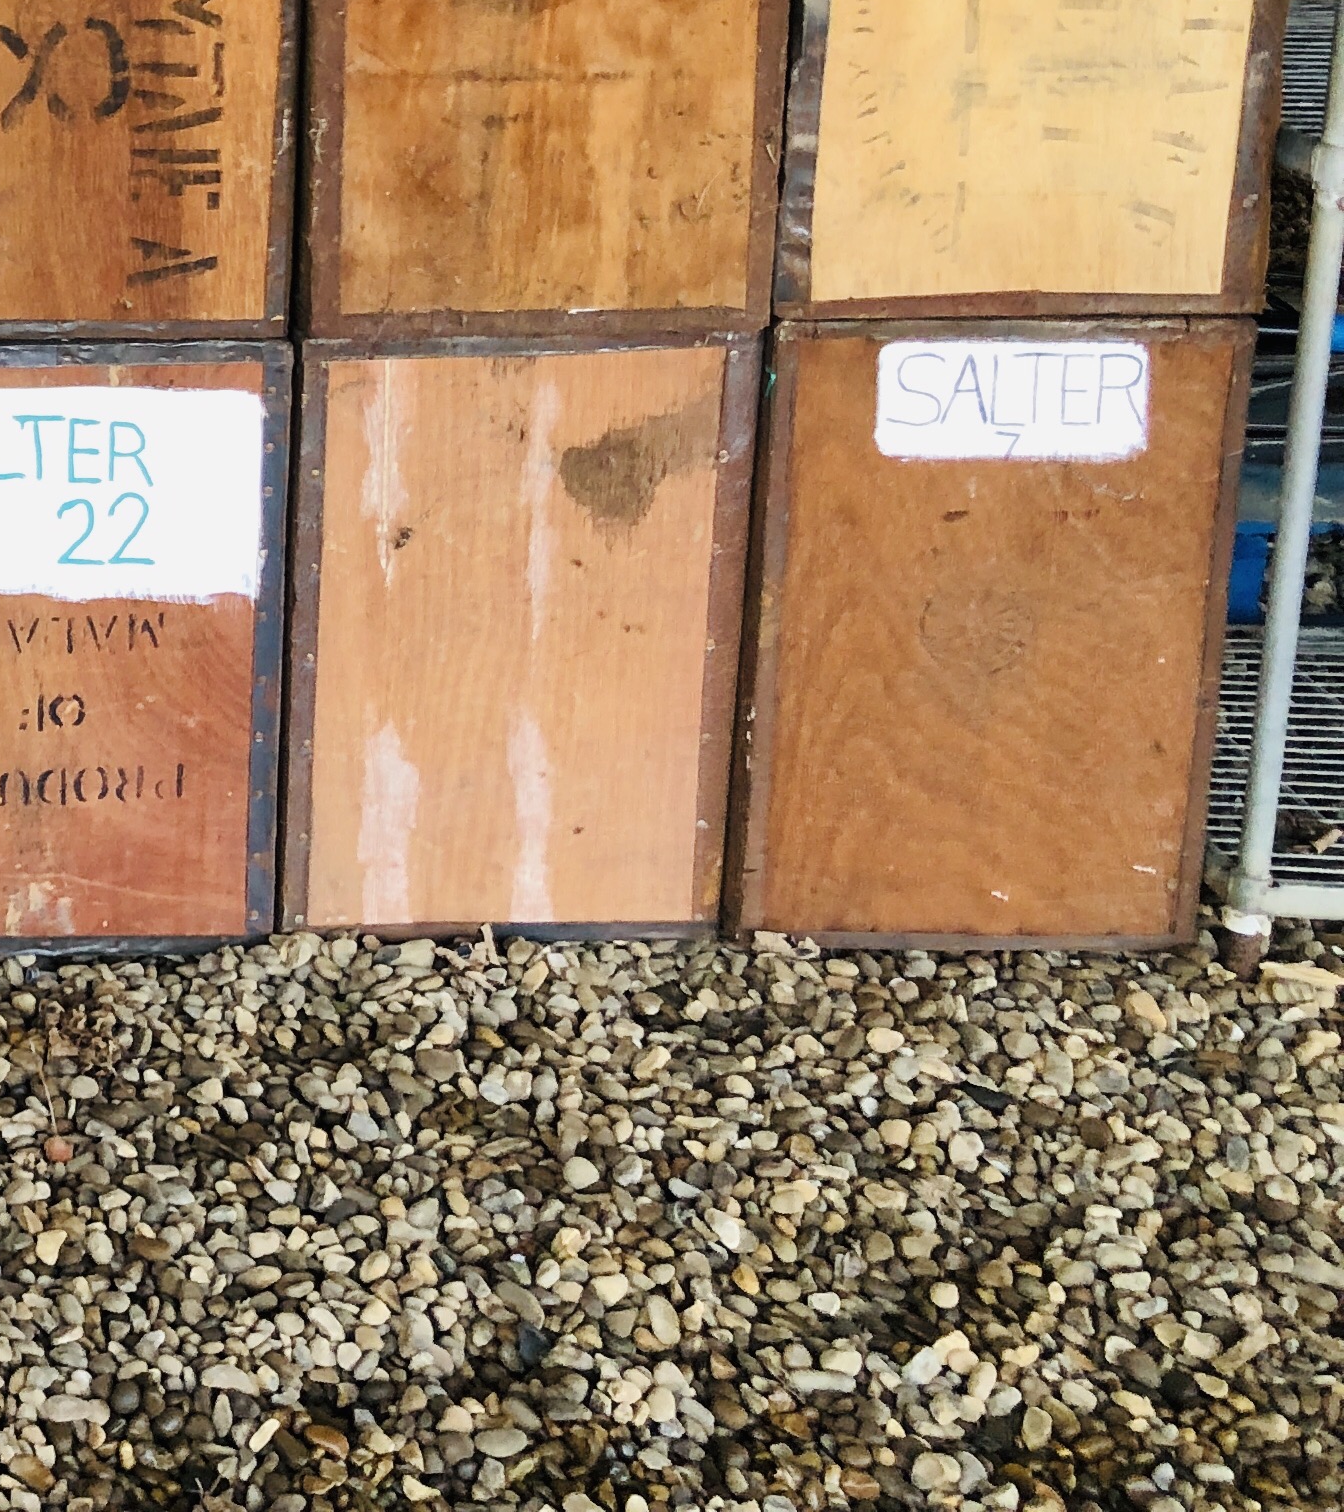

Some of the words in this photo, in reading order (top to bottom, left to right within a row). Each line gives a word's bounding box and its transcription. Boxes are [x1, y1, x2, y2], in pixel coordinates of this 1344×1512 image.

[885, 352, 1146, 428] SALTER
[994, 430, 1026, 460] 7
[56, 491, 157, 566] 22
